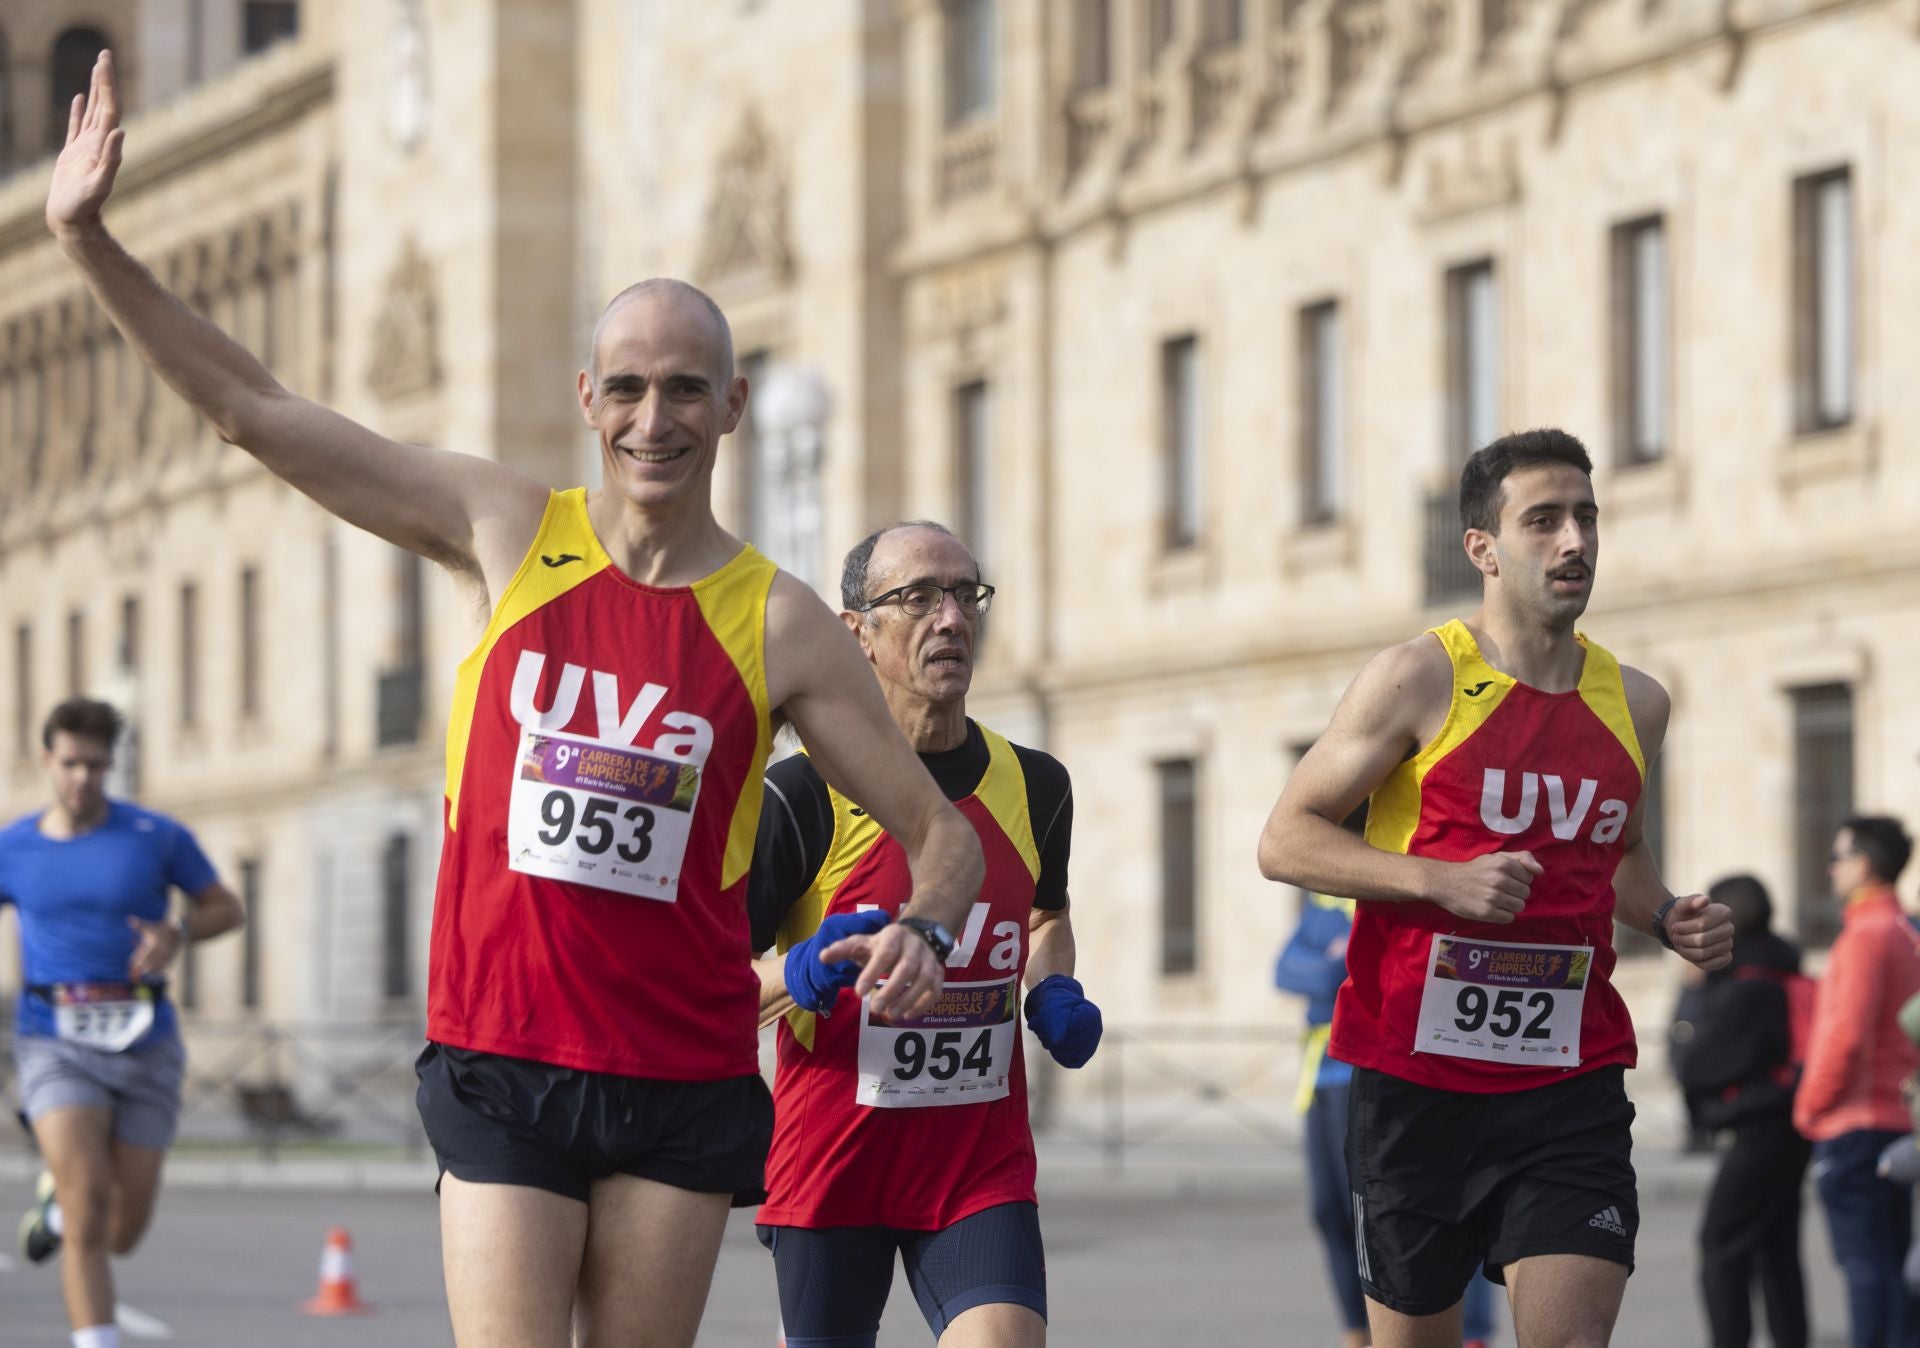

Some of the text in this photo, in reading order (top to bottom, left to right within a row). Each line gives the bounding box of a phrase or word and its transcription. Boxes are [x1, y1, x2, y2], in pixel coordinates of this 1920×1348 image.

[510, 649, 714, 760] UVa
[580, 748, 632, 768] CARRERA
[635, 758, 651, 774] DE
[577, 761, 648, 788] EMPRESAS
[1480, 767, 1628, 844] UVa
[538, 790, 656, 863] 953
[1489, 961, 1545, 976] EMPRESAS
[1490, 951, 1532, 963] CARRERA
[1535, 953, 1547, 964] DE
[924, 1001, 983, 1015] EMPRESAS
[972, 991, 984, 1002] DE
[1454, 985, 1555, 1039] 952
[893, 1028, 993, 1081] 954
[1588, 1218, 1626, 1237] adidas
